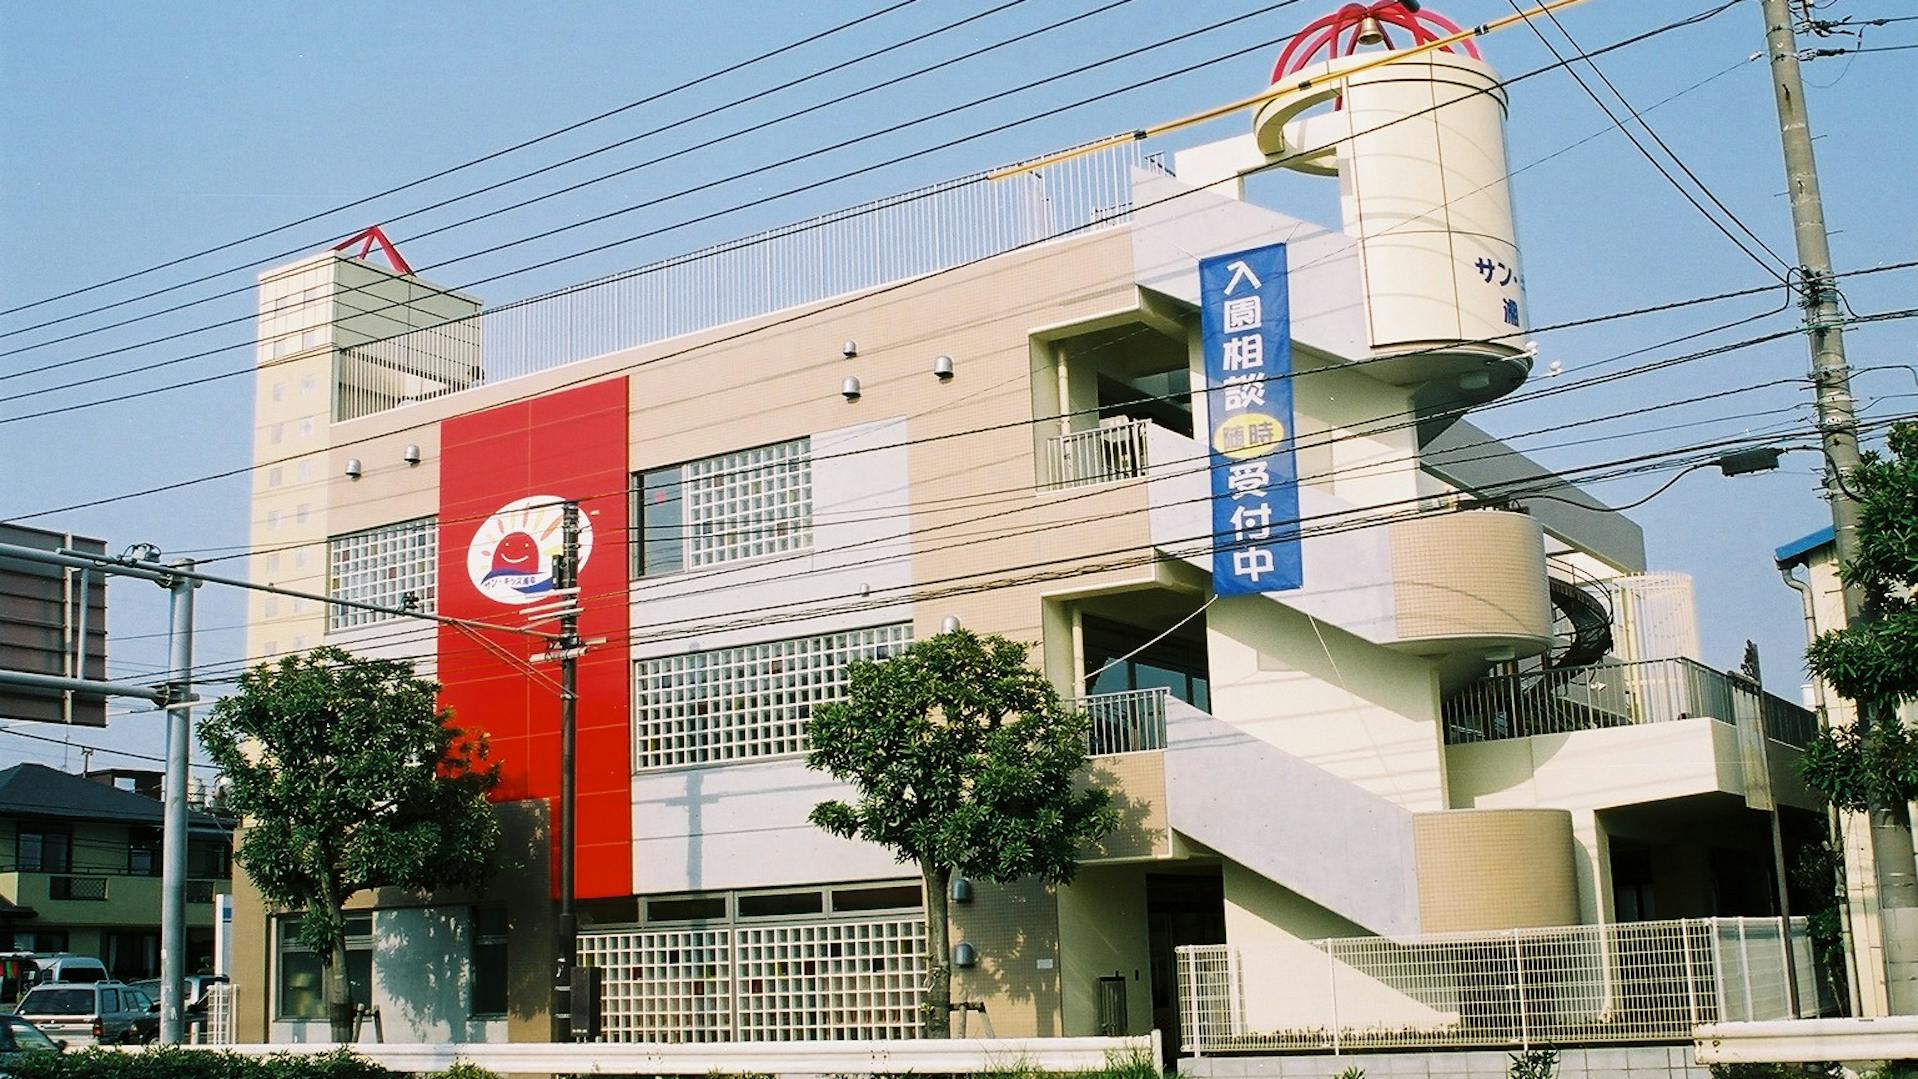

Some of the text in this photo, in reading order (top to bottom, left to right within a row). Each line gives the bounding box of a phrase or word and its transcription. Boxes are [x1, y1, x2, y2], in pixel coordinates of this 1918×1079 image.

[1223, 260, 1265, 412] 入園相談
[1228, 461, 1275, 582] 受付中
